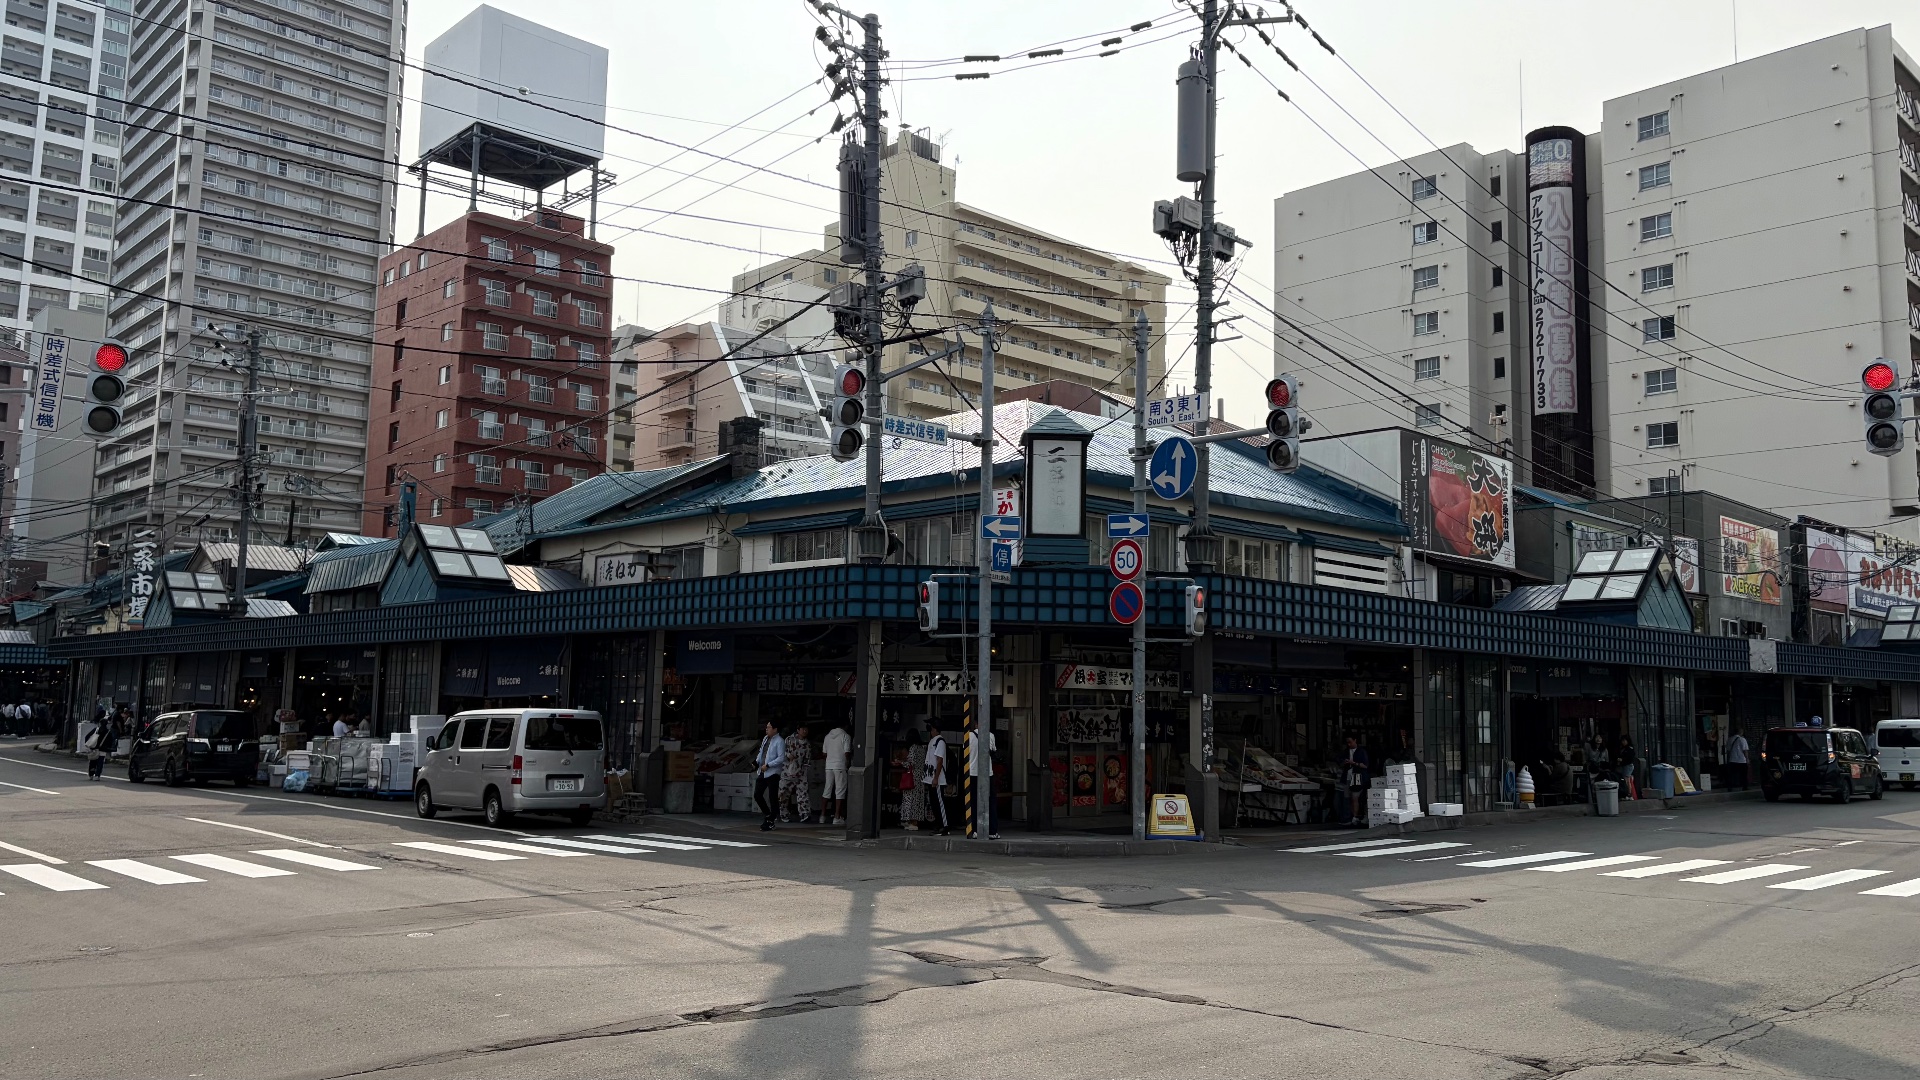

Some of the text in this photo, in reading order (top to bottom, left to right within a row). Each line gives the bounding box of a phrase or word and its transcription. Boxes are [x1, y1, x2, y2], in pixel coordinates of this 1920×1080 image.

[1531, 194, 1544, 279] アルファコート
[1536, 307, 1547, 409] 272-7733
[36, 338, 65, 429] 時差式信号機
[1148, 415, 1168, 426] South
[1170, 415, 1175, 423] 3
[1179, 412, 1194, 422] East
[885, 418, 946, 442] 時差式信号機
[996, 549, 1009, 567] 停
[1117, 552, 1135, 569] 50
[688, 639, 722, 651] Welcome
[497, 676, 521, 686] Welcome
